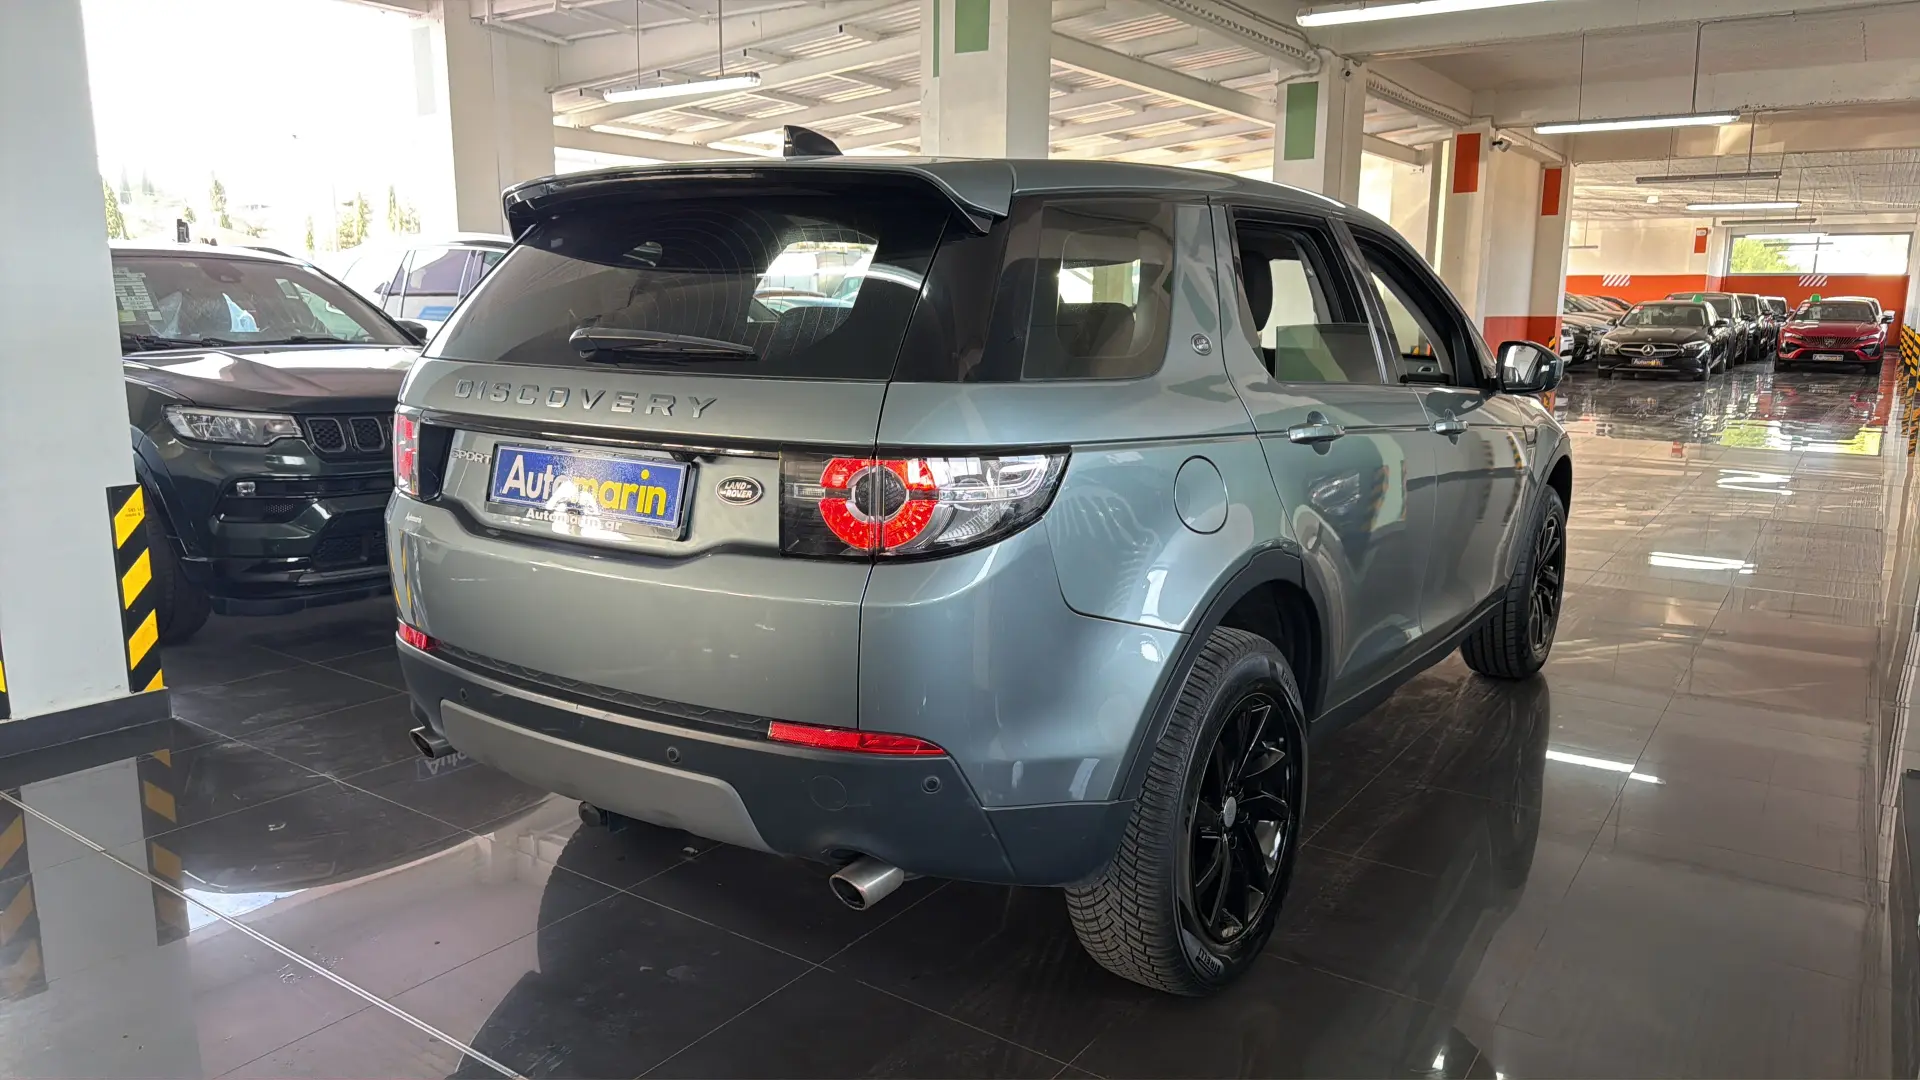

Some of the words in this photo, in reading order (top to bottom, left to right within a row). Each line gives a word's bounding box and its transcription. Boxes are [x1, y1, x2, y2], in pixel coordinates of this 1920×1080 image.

[454, 378, 717, 418] DISCOVERY
[452, 448, 492, 465] SPORT
[724, 481, 747, 490] LAND
[725, 489, 753, 498] ROVER
